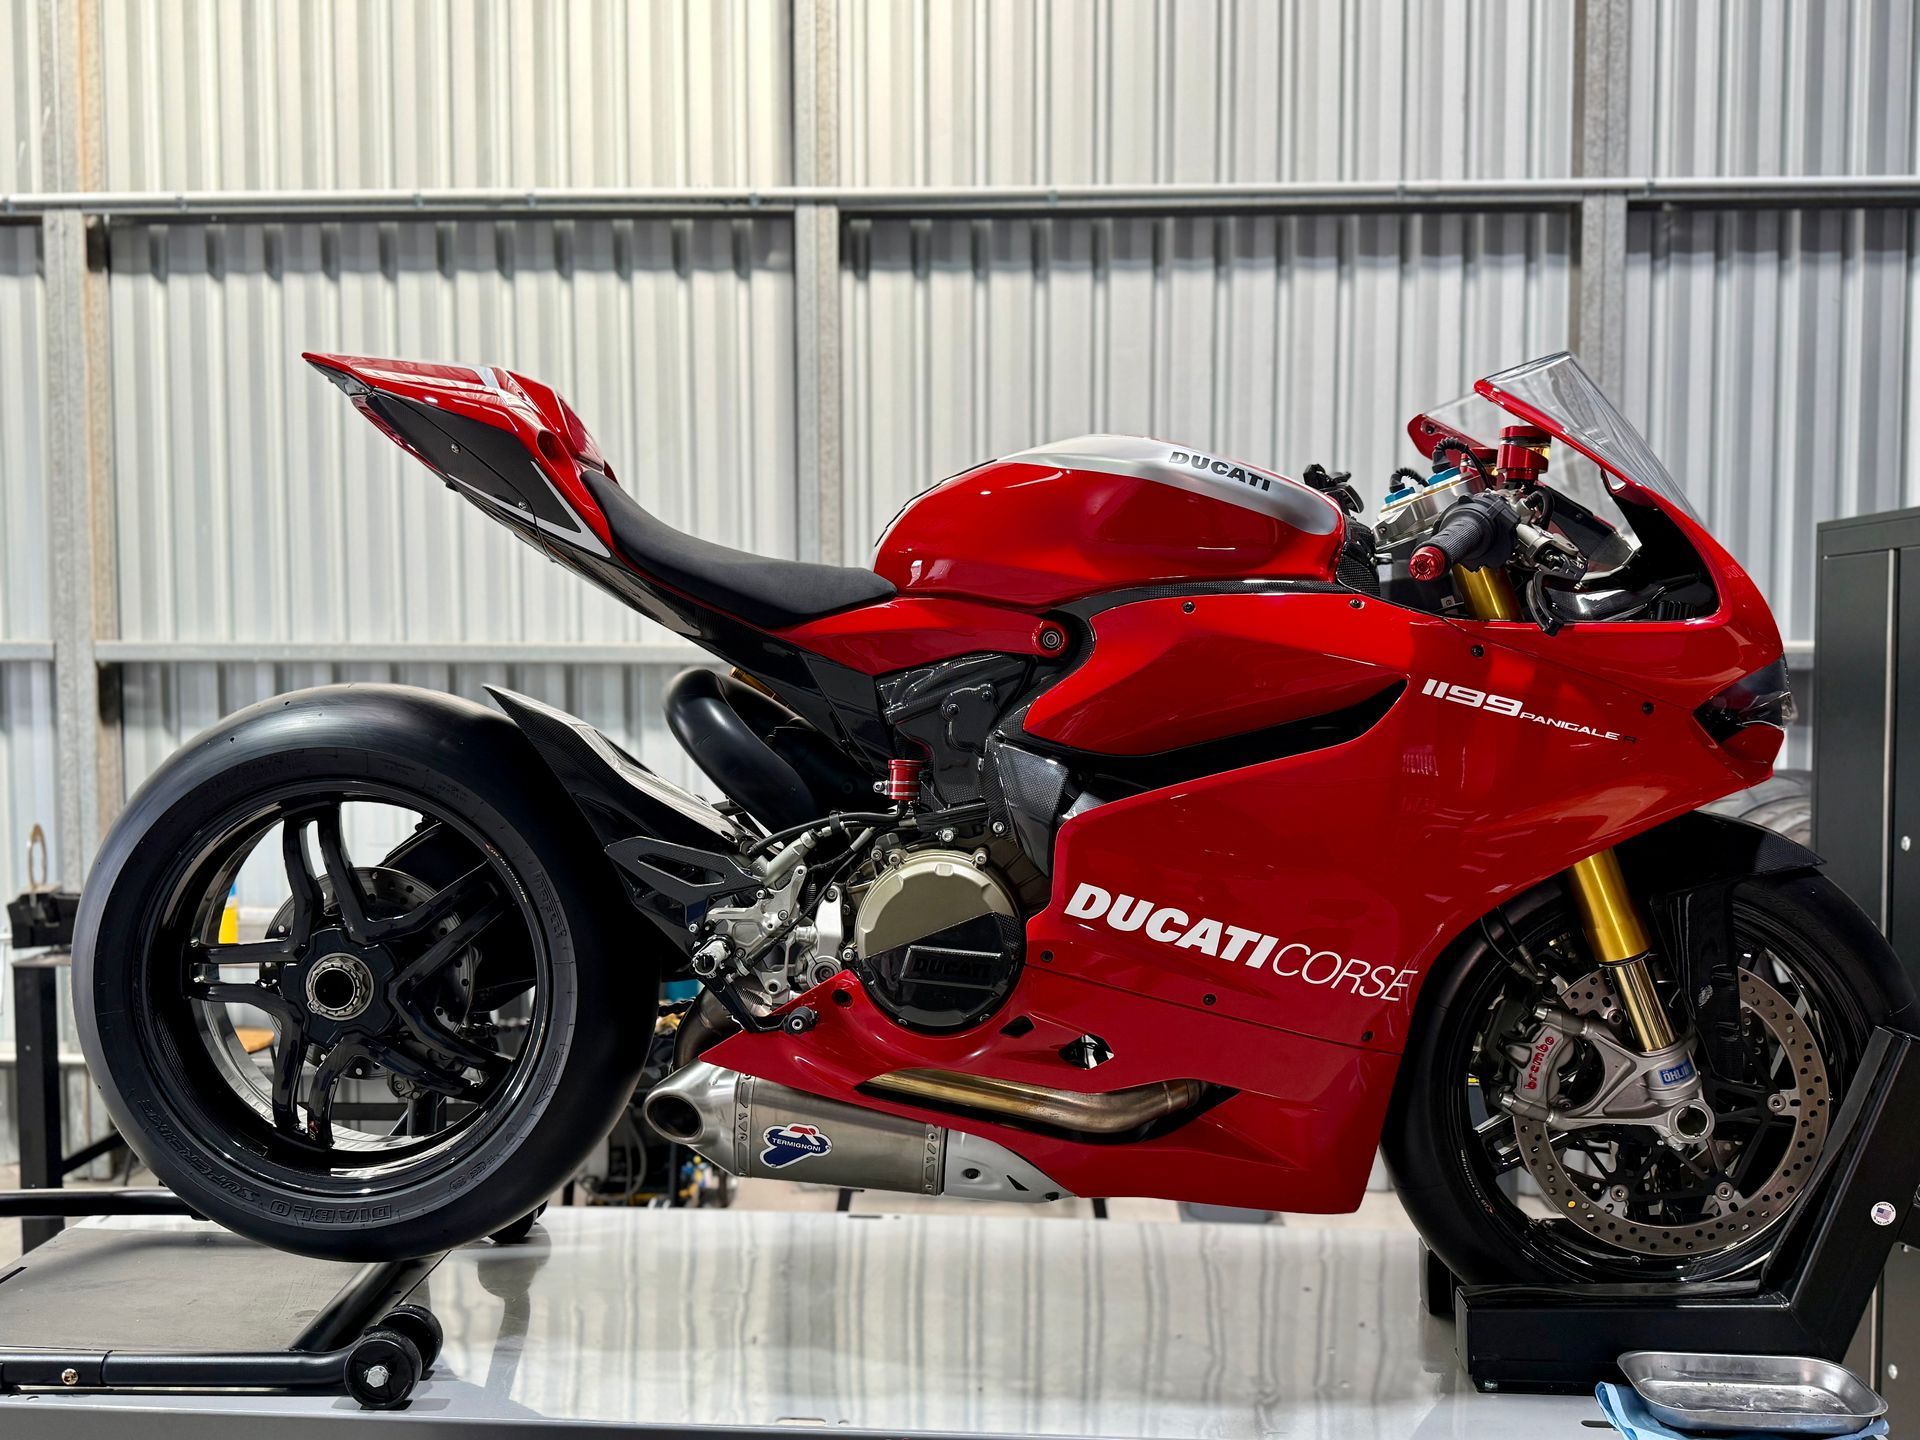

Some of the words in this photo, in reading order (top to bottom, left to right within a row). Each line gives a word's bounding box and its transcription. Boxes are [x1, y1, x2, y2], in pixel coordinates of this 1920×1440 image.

[1169, 451, 1271, 491] DUCATI
[1421, 678, 1524, 717] 1199
[1519, 711, 1621, 741] PANIGALE
[1063, 882, 1280, 969] DUCATI
[1272, 943, 1419, 1002] CORSE
[912, 957, 993, 979] DUCATI
[1523, 1036, 1555, 1091] brembo
[772, 1137, 821, 1152] TERMIGNONI
[270, 1200, 393, 1224] DIABLO
